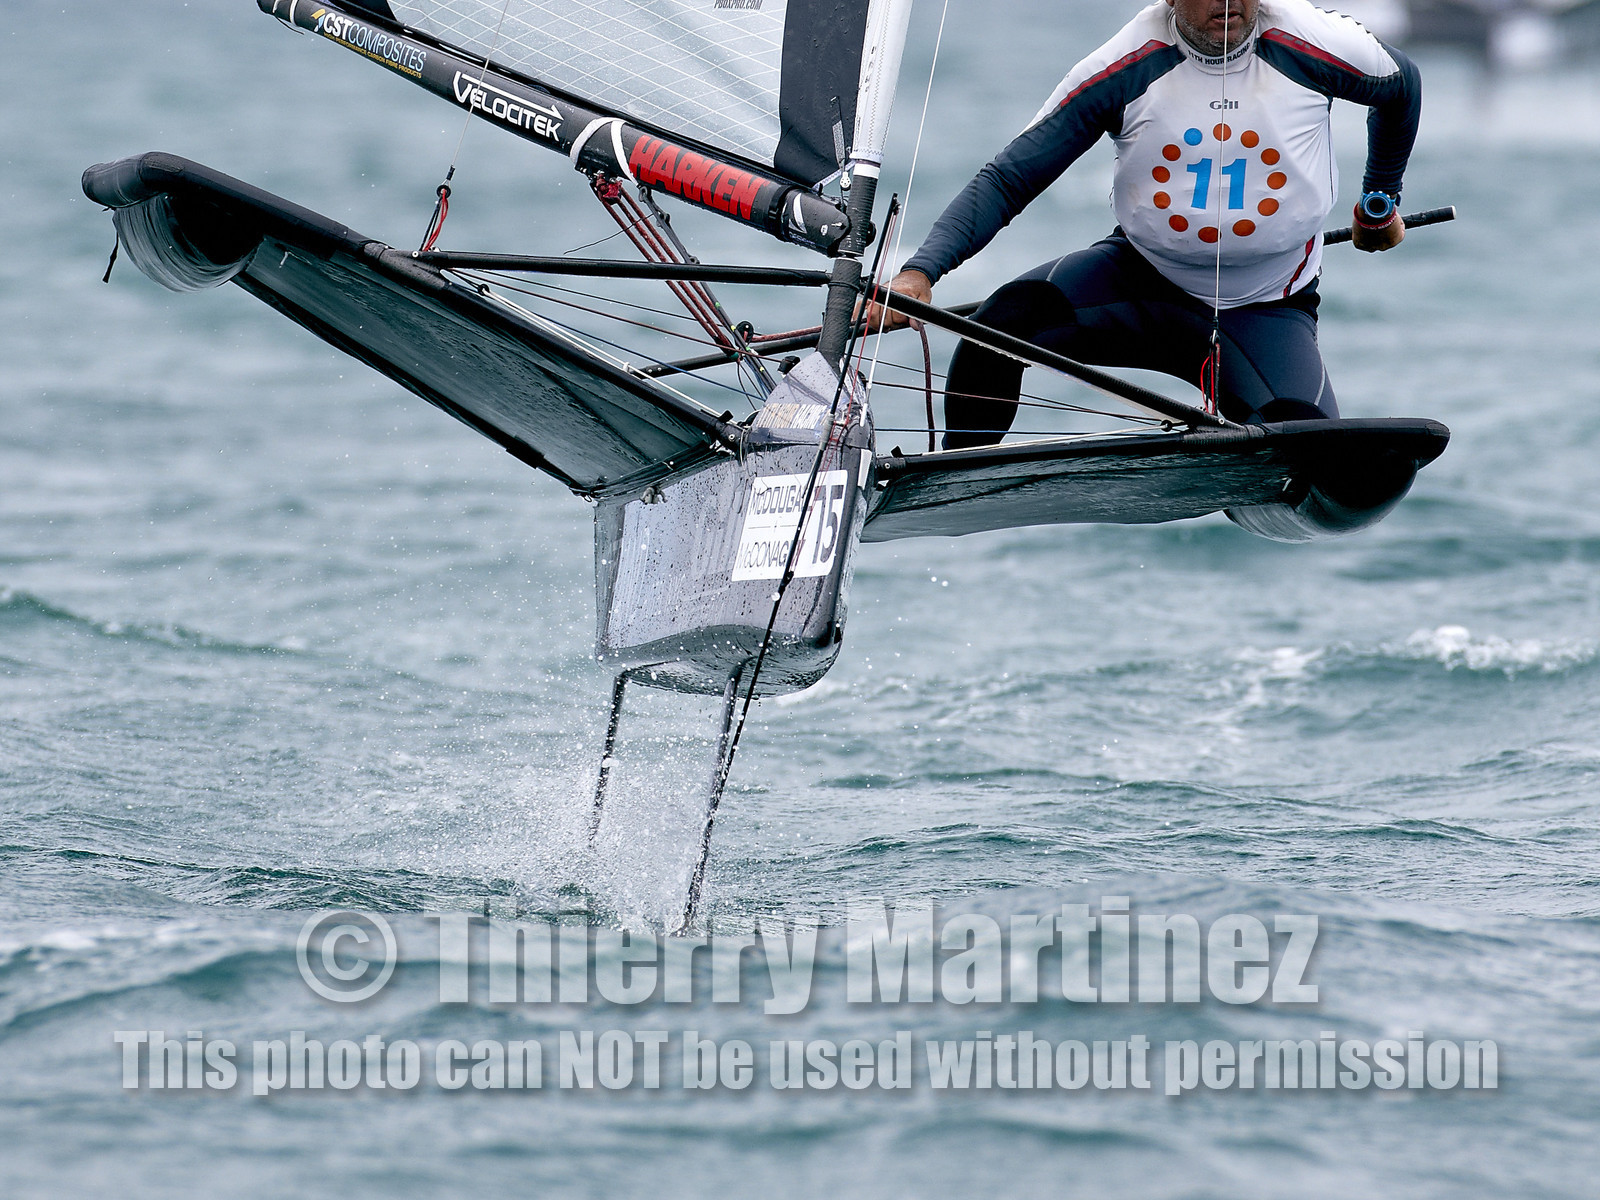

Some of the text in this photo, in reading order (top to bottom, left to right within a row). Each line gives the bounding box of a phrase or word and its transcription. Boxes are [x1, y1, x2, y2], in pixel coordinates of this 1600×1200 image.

[398, 64, 422, 79] PRODUCTS
[1205, 57, 1225, 66] HOUR
[453, 70, 562, 142] VELOCITEK
[1209, 98, 1239, 110] Gill
[629, 135, 767, 220] HARKEN
[1186, 157, 1247, 210] 11
[812, 484, 845, 564] 75
